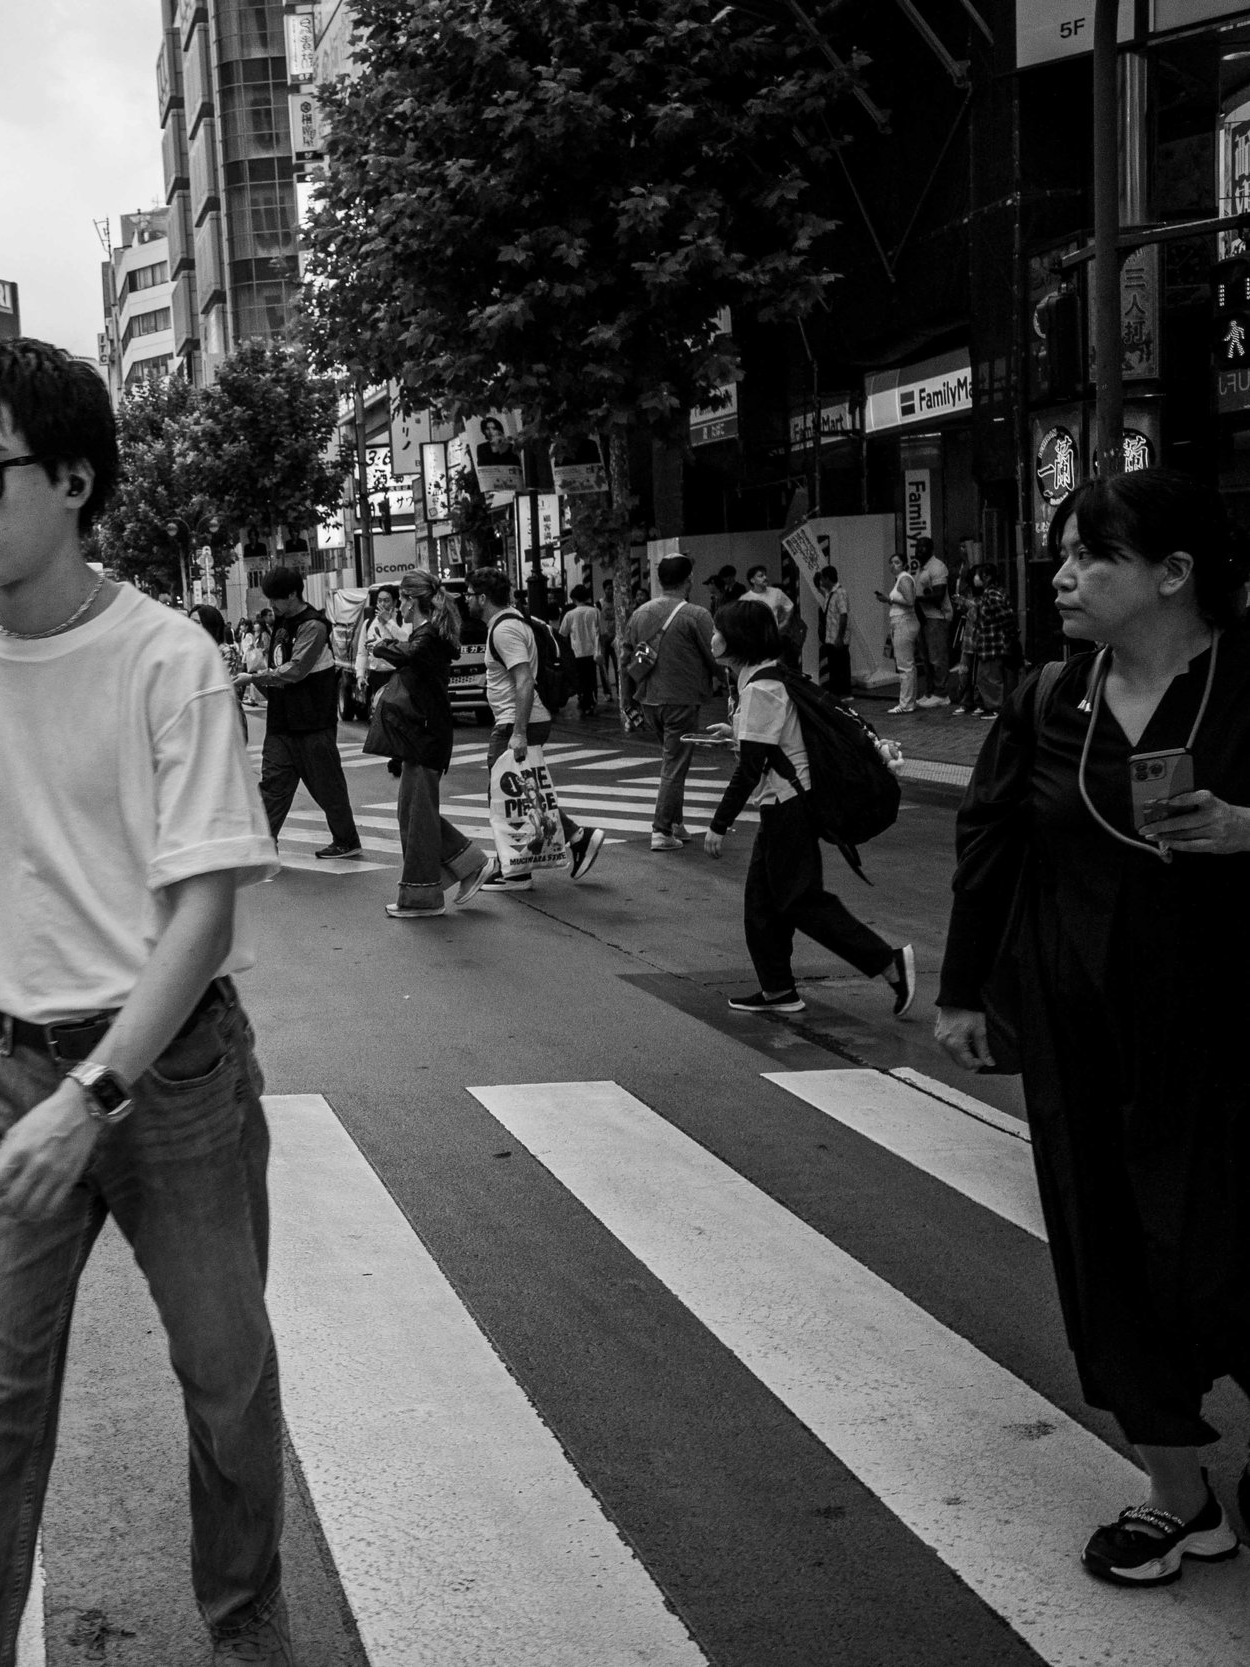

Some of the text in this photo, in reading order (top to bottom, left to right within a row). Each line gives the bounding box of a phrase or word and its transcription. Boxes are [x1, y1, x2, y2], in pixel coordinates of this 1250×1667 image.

[1060, 17, 1086, 39] 5F
[1037, 435, 1074, 492] 一蘭
[376, 563, 415, 573] ocomo
[460, 645, 486, 654] 圧ガス
[500, 766, 552, 797] ONE
